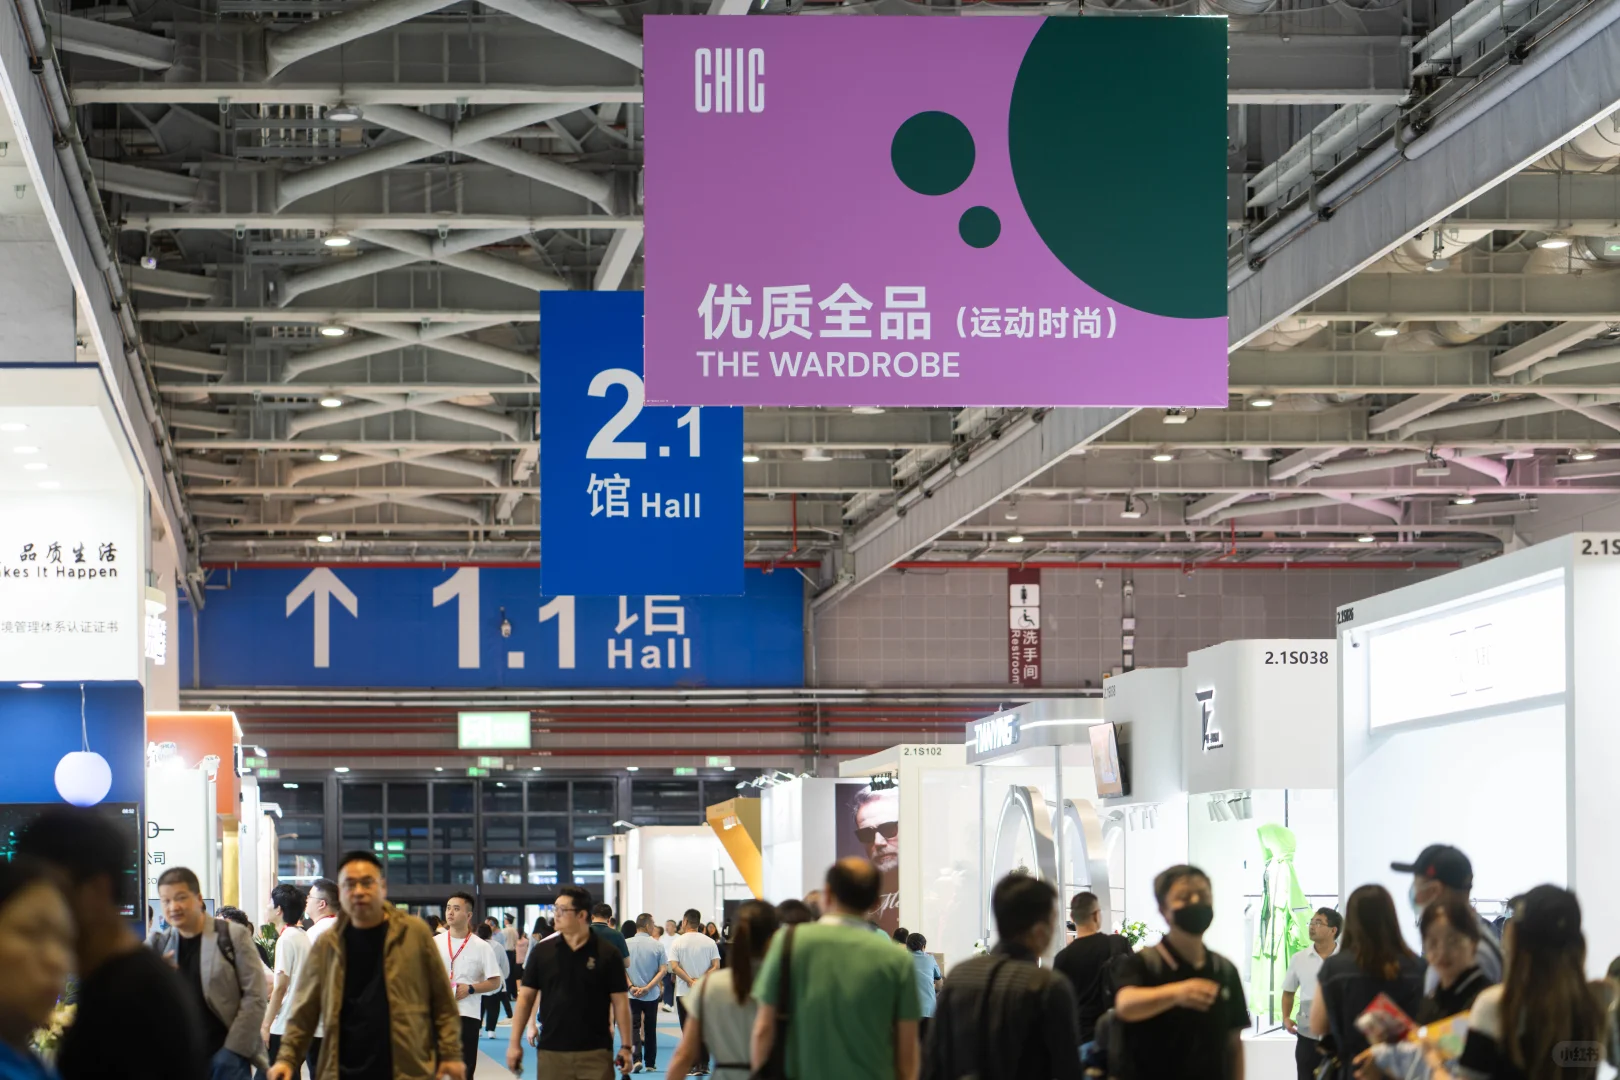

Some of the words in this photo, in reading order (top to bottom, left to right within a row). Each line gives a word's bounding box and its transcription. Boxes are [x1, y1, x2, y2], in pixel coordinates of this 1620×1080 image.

[695, 47, 765, 113] CHIC
[697, 282, 931, 340] 优质全品
[696, 351, 759, 377] THE
[769, 351, 960, 378] WARDROBE
[586, 368, 701, 459] 2.1
[586, 472, 631, 518] 馆
[641, 493, 701, 518] Hall
[0, 566, 29, 578] kes
[37, 566, 48, 578] It
[56, 566, 118, 580] Happen
[19, 541, 117, 564] 品质生活
[433, 566, 575, 669] 1.1
[607, 638, 691, 669] Hall
[1011, 630, 1021, 684] Restroom
[1022, 630, 1039, 680] 洗手间
[1265, 651, 1329, 665] 2.1S038
[904, 747, 942, 756] 2.1S102
